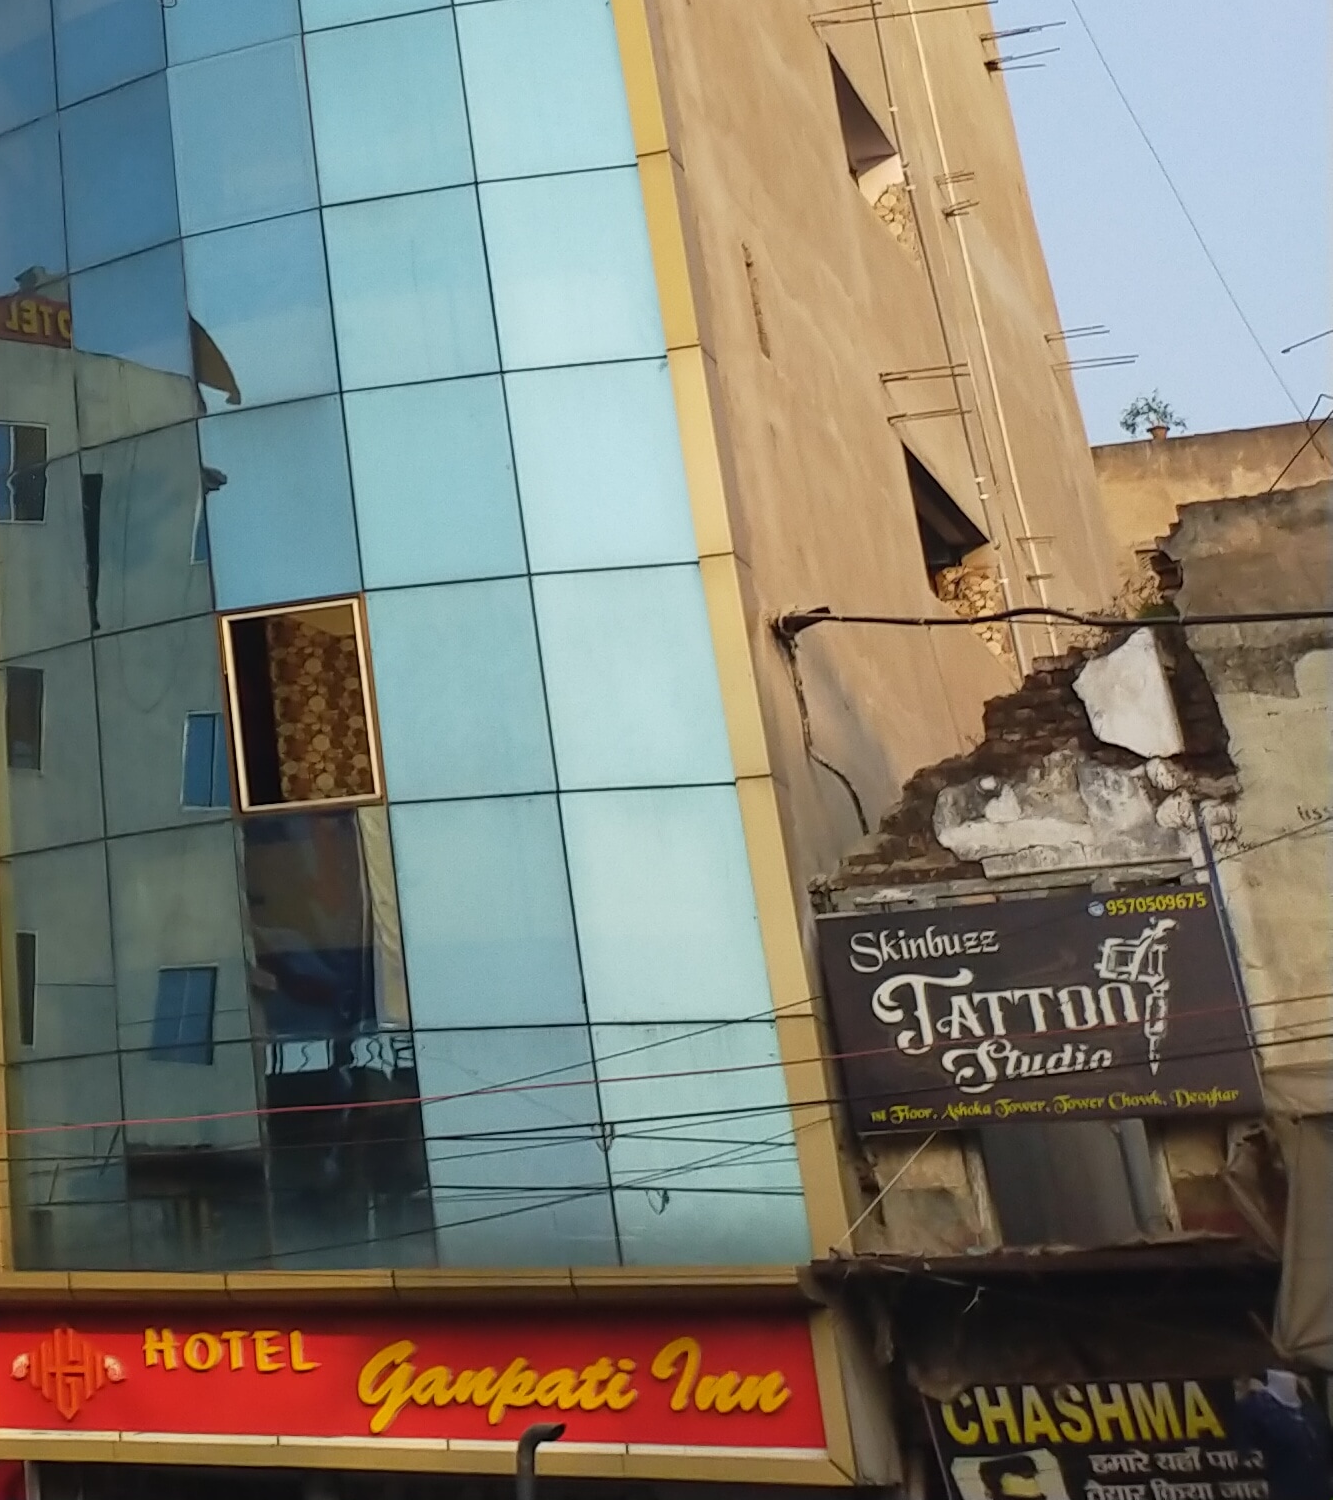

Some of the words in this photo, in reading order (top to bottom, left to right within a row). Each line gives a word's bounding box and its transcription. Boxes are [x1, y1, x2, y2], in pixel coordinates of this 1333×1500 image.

[1106, 891, 1207, 916] 9570509675
[849, 925, 1000, 973] Skinbuzz
[941, 1038, 1113, 1094] Studio
[1053, 1093, 1105, 1115] Tower
[142, 1327, 322, 1373] HOTEL
[358, 1339, 638, 1434] Ganpati
[651, 1336, 792, 1413] Inn
[942, 1380, 1226, 1445] CHASHMA
